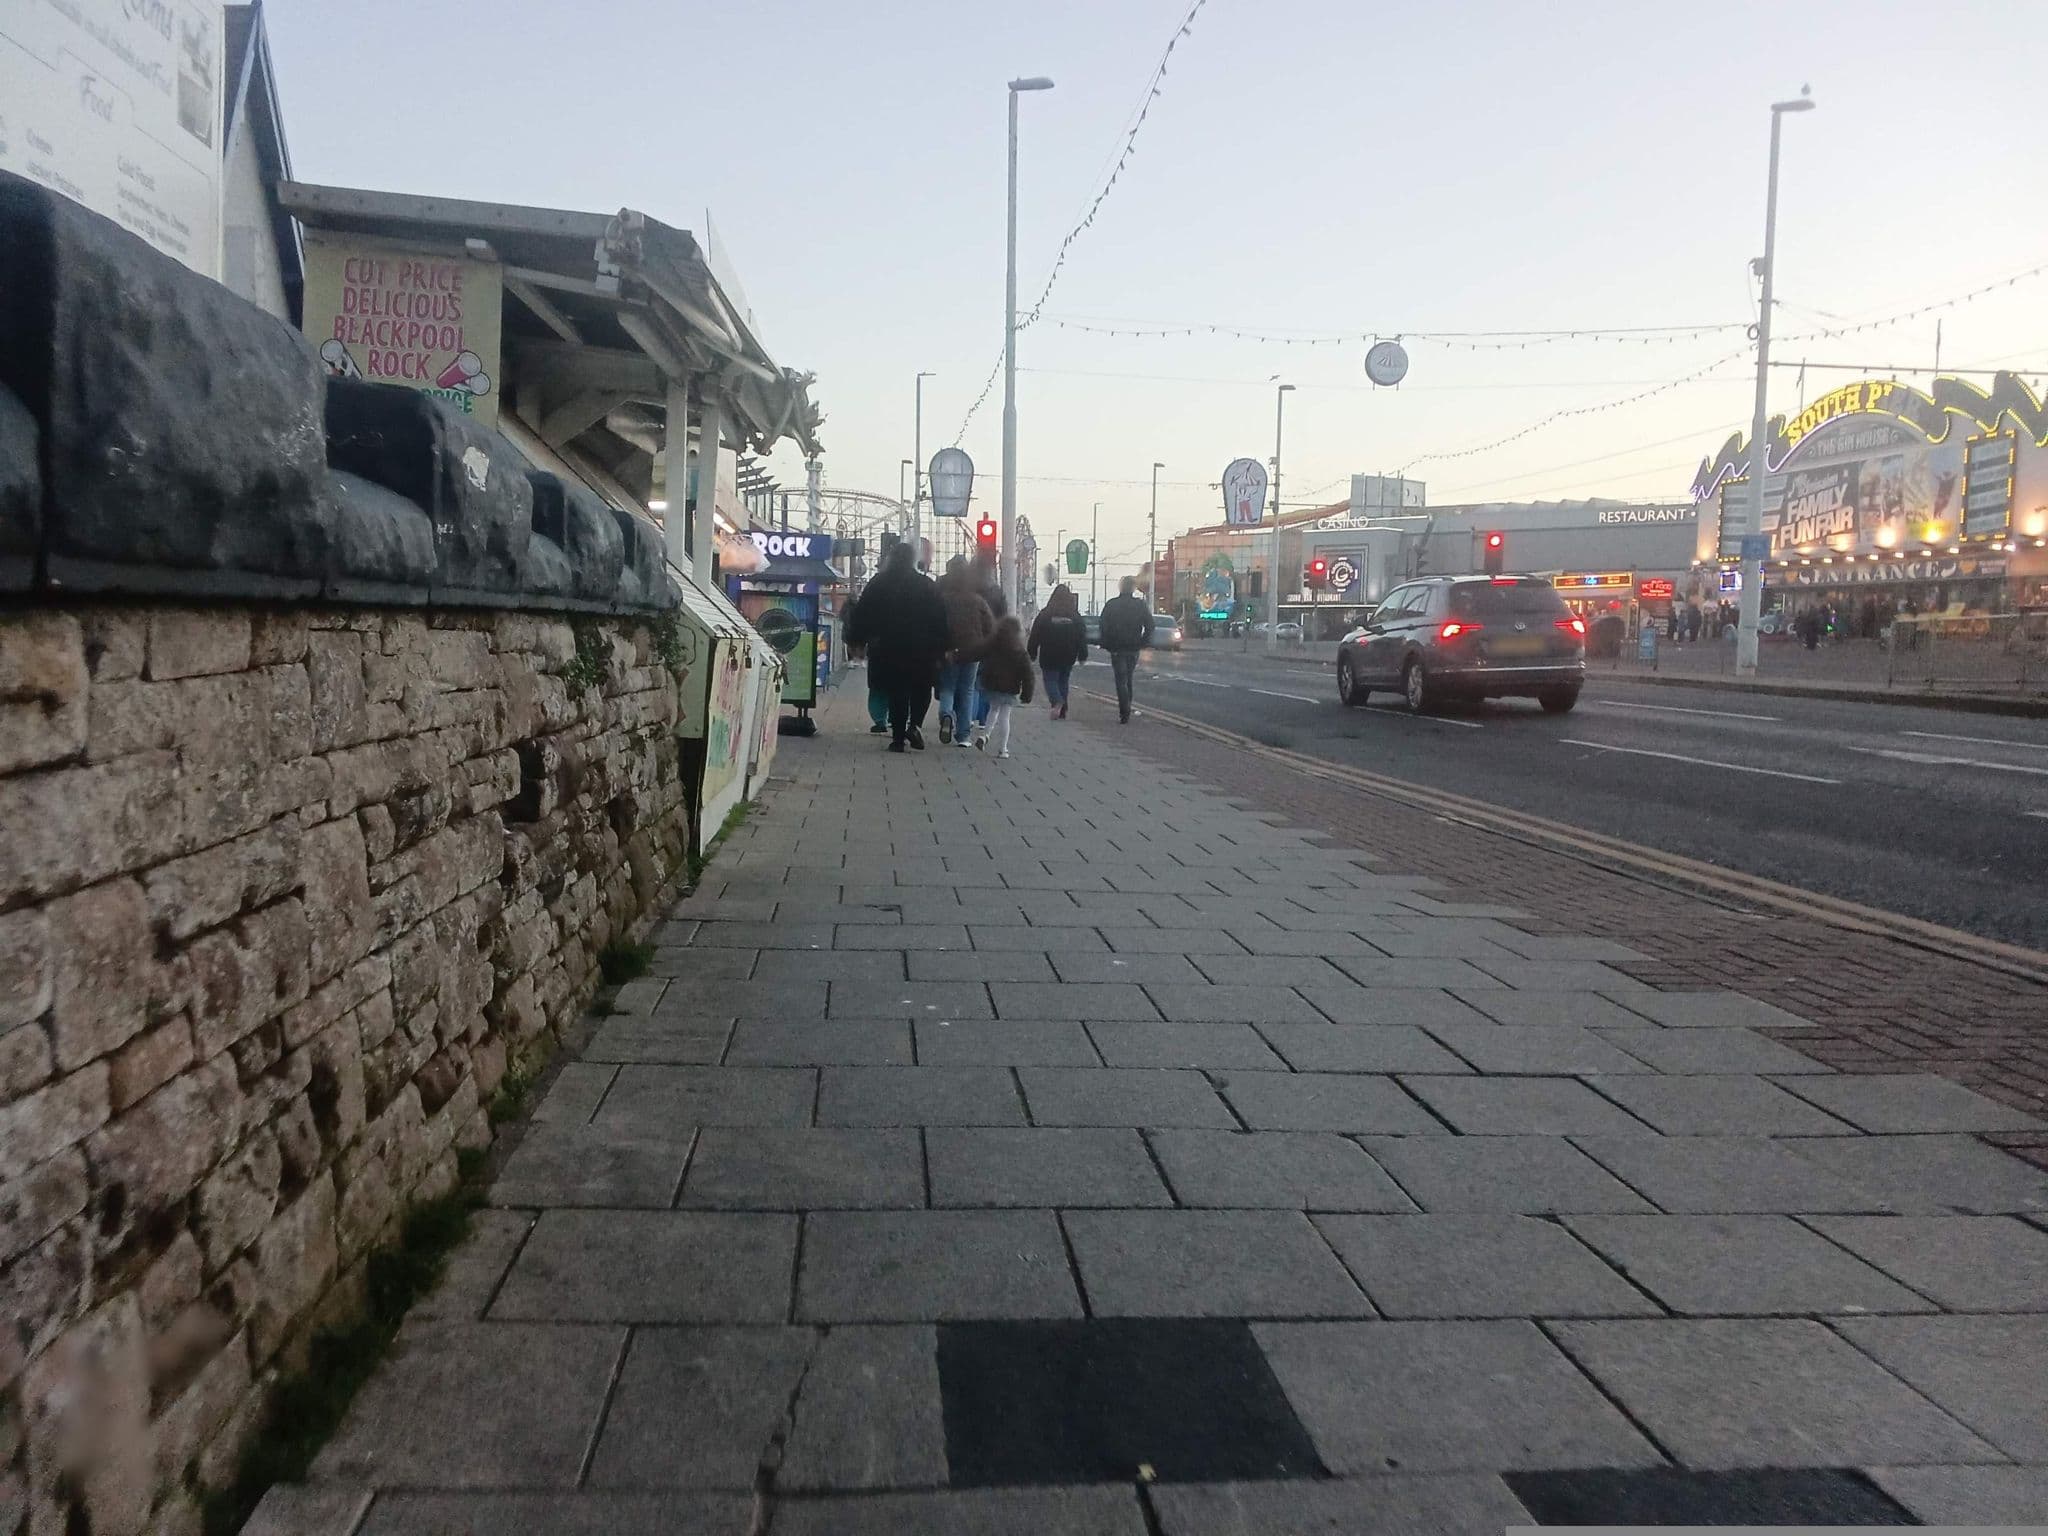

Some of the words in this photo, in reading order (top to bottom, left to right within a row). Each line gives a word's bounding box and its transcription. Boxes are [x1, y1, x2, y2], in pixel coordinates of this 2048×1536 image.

[345, 257, 386, 285] CUT
[398, 259, 464, 292] PRICE
[343, 287, 462, 321] DELICIOUS
[333, 316, 465, 353] BLACKPOOL
[367, 349, 431, 380] ROCK
[1787, 384, 1862, 448] SOUTH
[1598, 509, 1687, 523] RESTAURANT
[1787, 482, 1848, 524] FAMILY
[751, 532, 811, 557] ROCK
[1812, 561, 1939, 584] ENTRANCE
